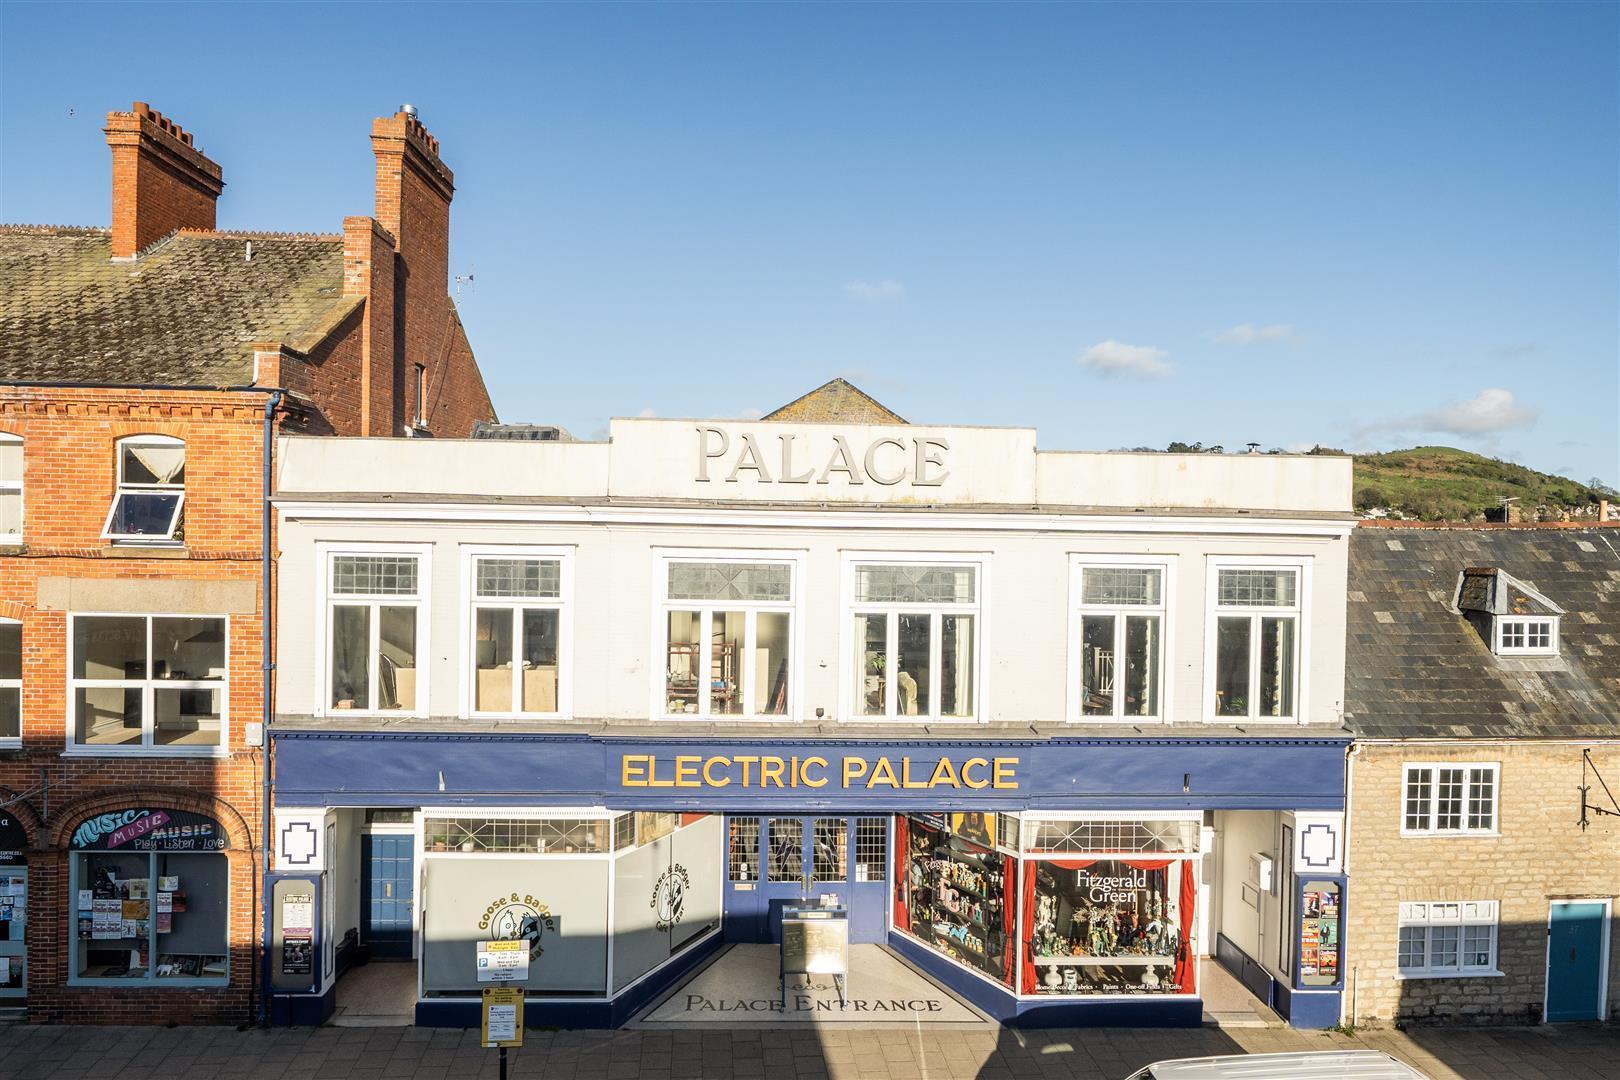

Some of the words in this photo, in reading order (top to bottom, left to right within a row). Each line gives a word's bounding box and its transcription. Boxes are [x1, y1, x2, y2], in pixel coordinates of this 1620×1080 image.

[694, 425, 951, 488] PALACE
[621, 754, 829, 788] ELECTRIC
[842, 756, 1019, 790] PALACE
[114, 815, 162, 844] MUSIC
[150, 823, 213, 841] MUSIC
[202, 838, 224, 850] Love
[650, 872, 667, 908] Goose
[1077, 868, 1147, 892] Fitzgerald
[1089, 887, 1137, 903] Green
[478, 897, 508, 931] Goose
[510, 892, 520, 903] &
[523, 894, 555, 932] Badger
